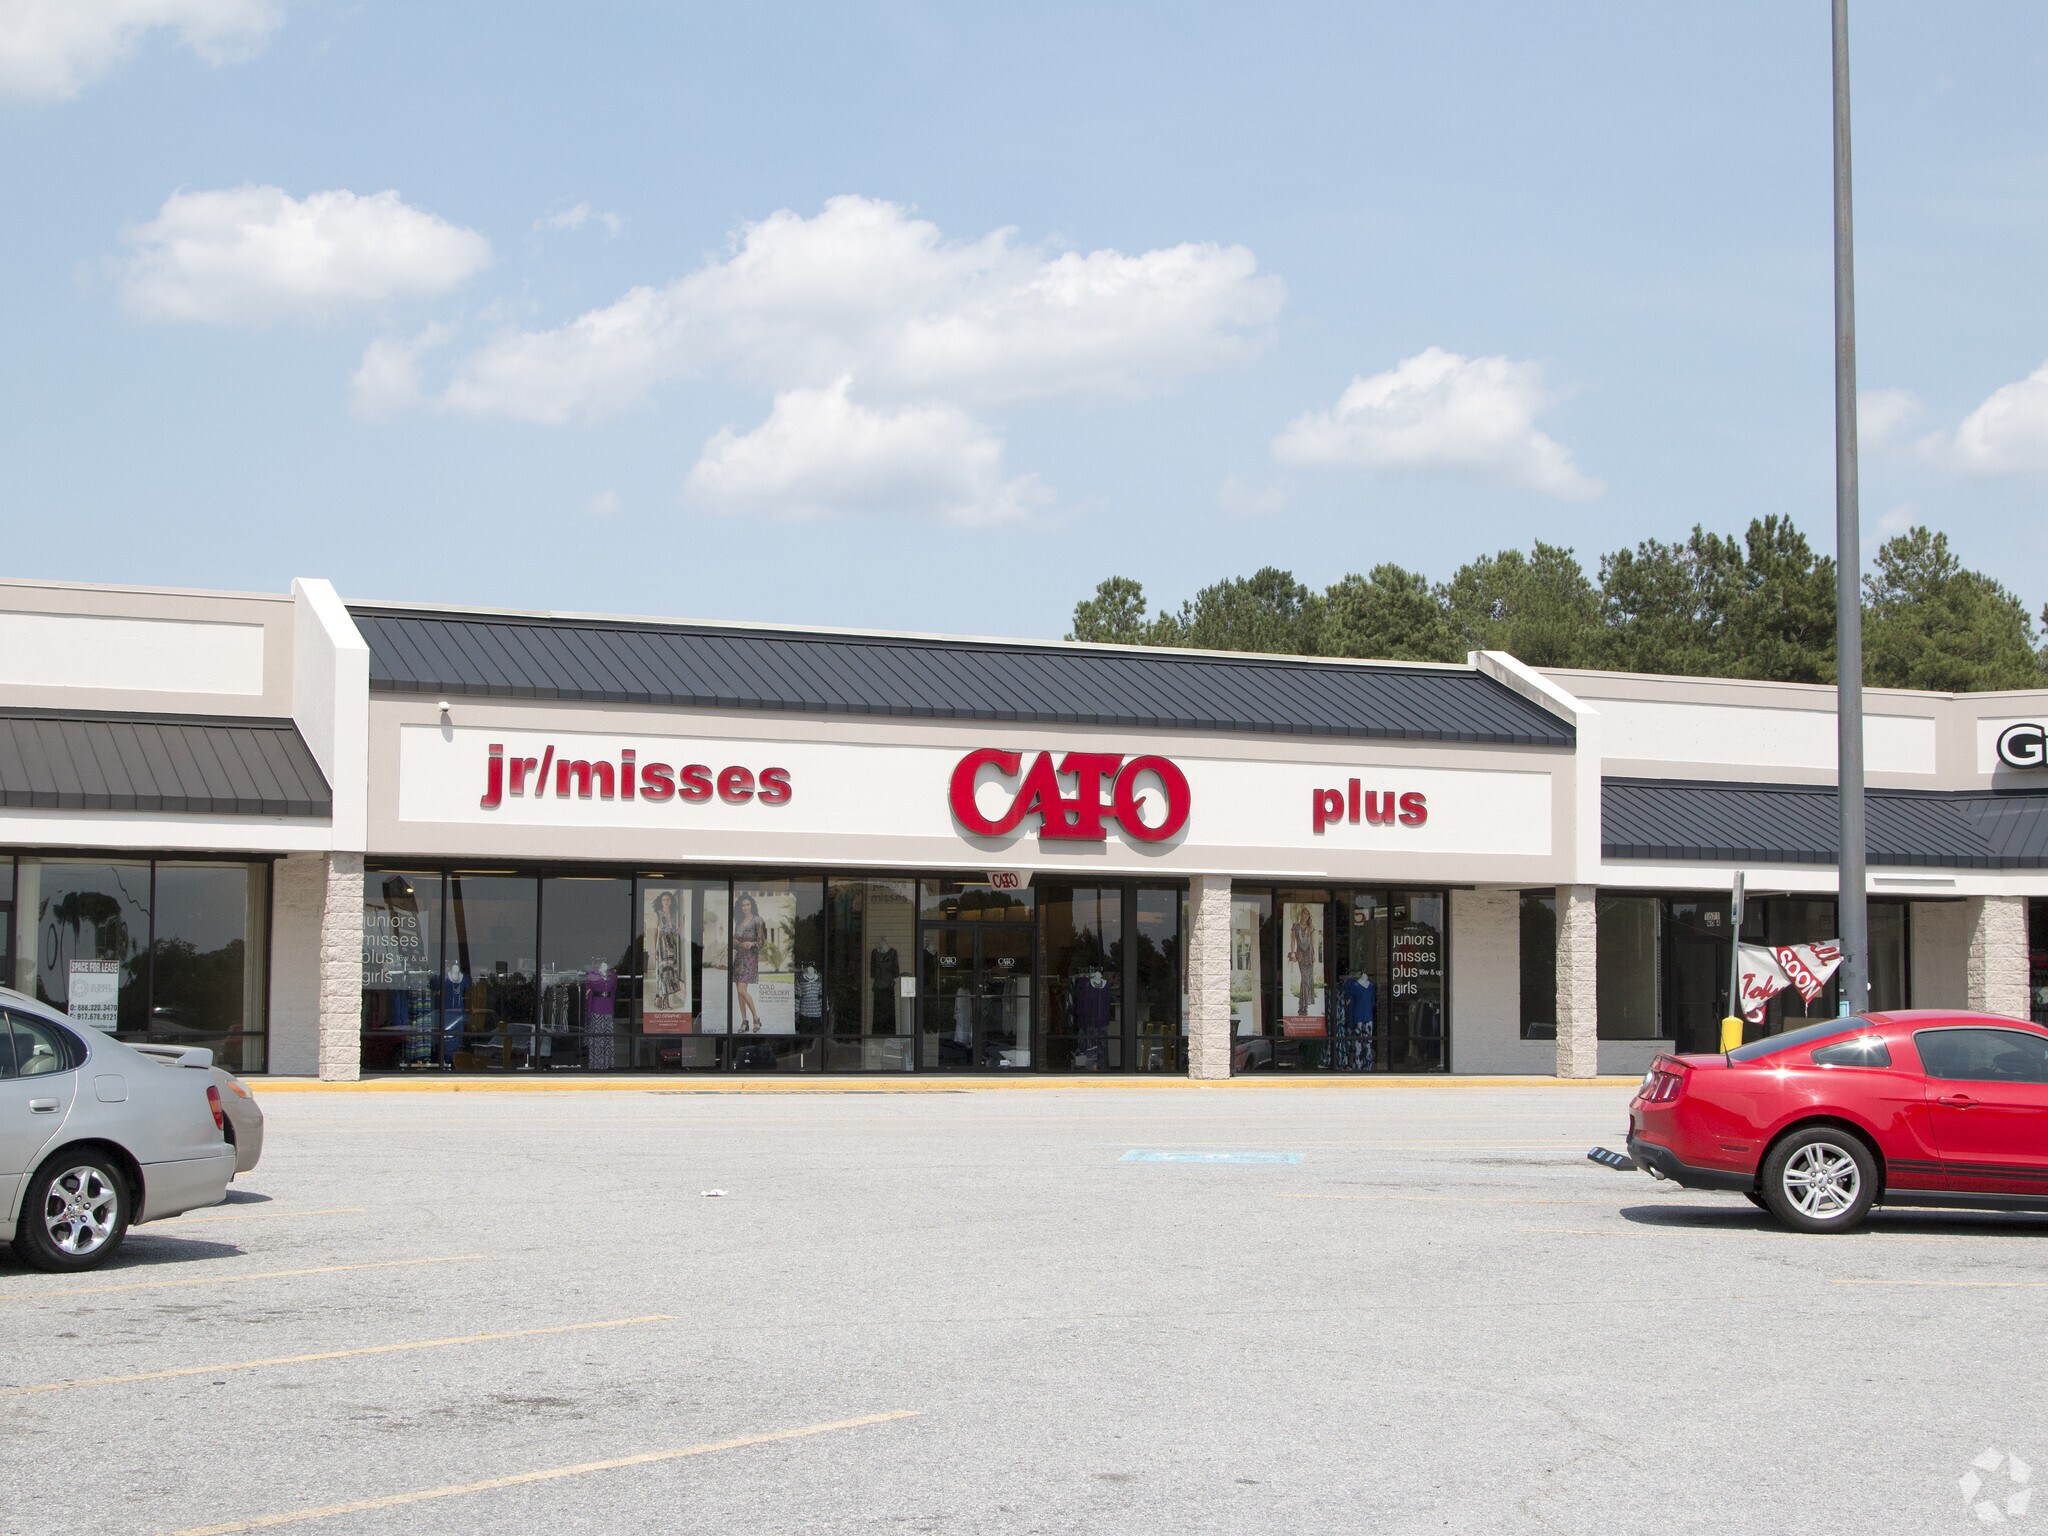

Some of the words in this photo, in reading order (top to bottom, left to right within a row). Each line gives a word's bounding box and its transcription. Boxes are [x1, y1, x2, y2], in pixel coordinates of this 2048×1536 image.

[1997, 723, 2048, 769] G
[480, 744, 792, 808] jr/misses
[949, 748, 1191, 842] CATO
[1313, 778, 1428, 835] plus
[992, 873, 1018, 888] CATO
[363, 916, 416, 930] juniors
[1393, 935, 1434, 948] juniors
[1392, 952, 1436, 962] misses
[71, 962, 88, 972] SPACE
[89, 962, 100, 972] FOR
[101, 963, 118, 973] LEASE
[1392, 965, 1418, 980] plus
[1780, 950, 1821, 1000] SOON
[362, 969, 393, 986] girls
[1393, 981, 1418, 997] girls
